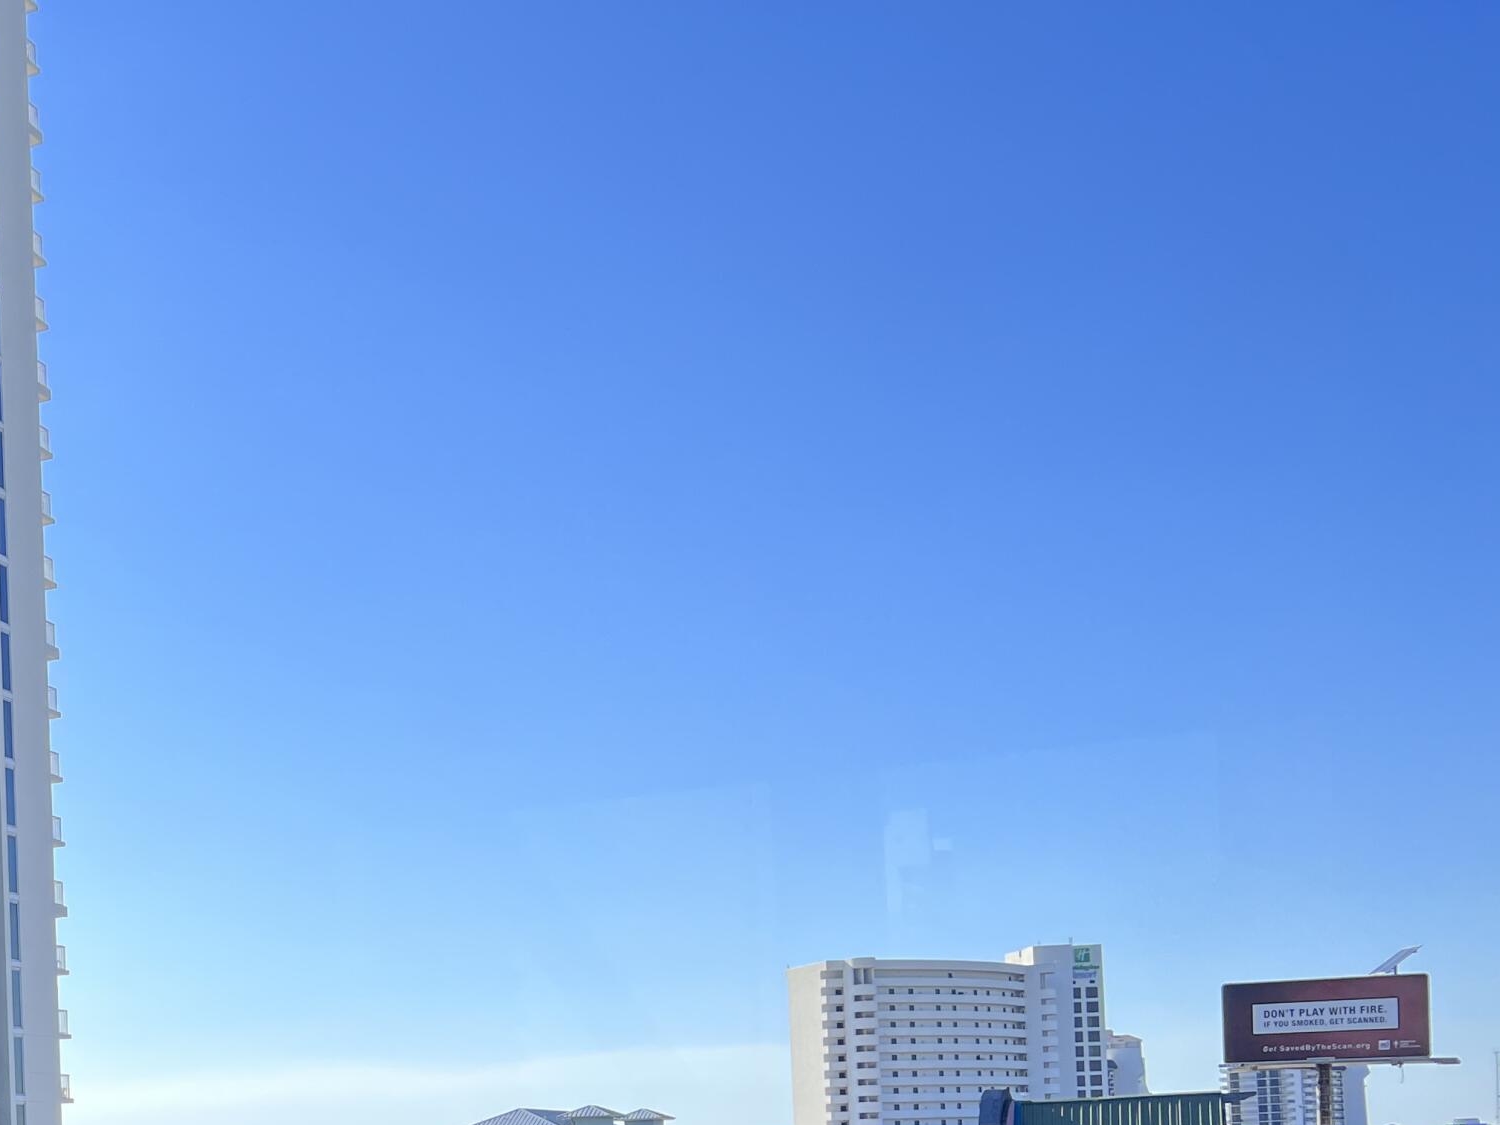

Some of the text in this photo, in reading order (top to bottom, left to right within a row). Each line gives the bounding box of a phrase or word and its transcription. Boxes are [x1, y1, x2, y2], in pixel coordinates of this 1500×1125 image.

[1263, 1009, 1295, 1019] DON'T
[1300, 1008, 1325, 1017] PLAY
[1329, 1006, 1357, 1016] WITH
[1262, 1045, 1277, 1053] Get
[1279, 1042, 1371, 1053] SavedByTheScan.org
